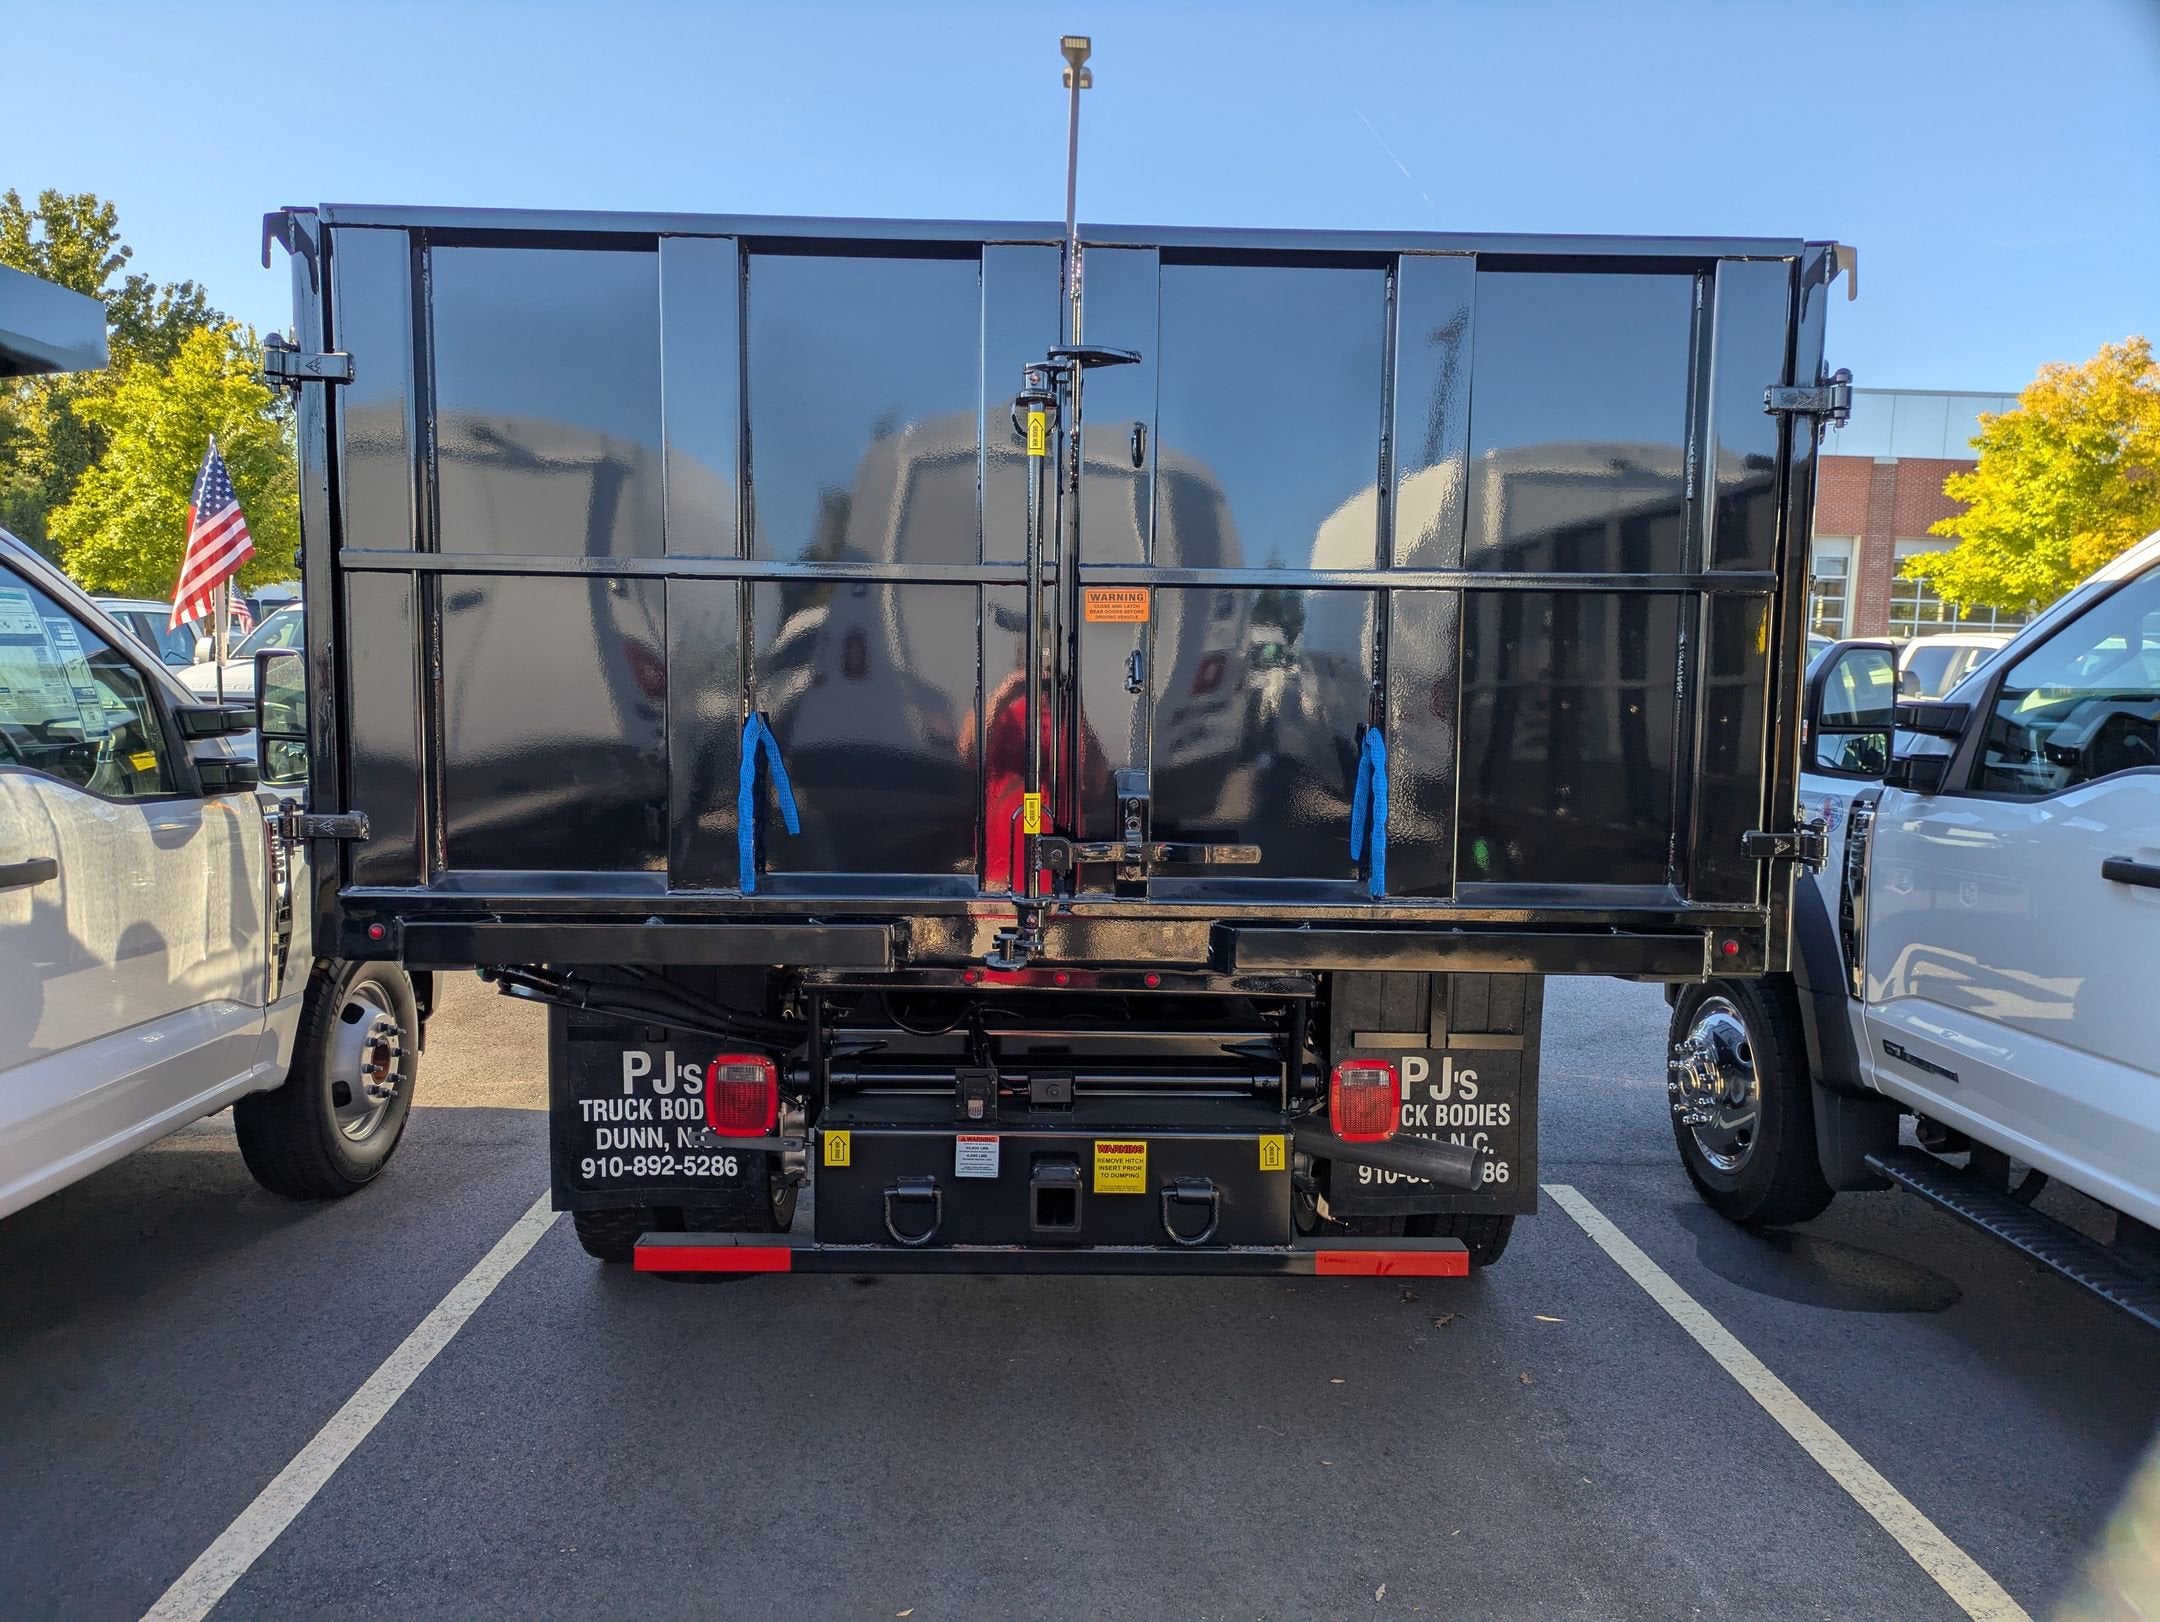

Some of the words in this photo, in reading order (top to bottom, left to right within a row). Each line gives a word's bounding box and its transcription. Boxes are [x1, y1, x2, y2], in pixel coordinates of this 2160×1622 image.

[1090, 593, 1144, 601] WARNING
[579, 1099, 653, 1122] TRUCK
[661, 1098, 704, 1121] BOD
[1435, 1103, 1511, 1127] BODIES
[596, 1127, 670, 1152] DUNN,
[1096, 1144, 1145, 1154] WARNING
[581, 1155, 738, 1179] 910-892-5286
